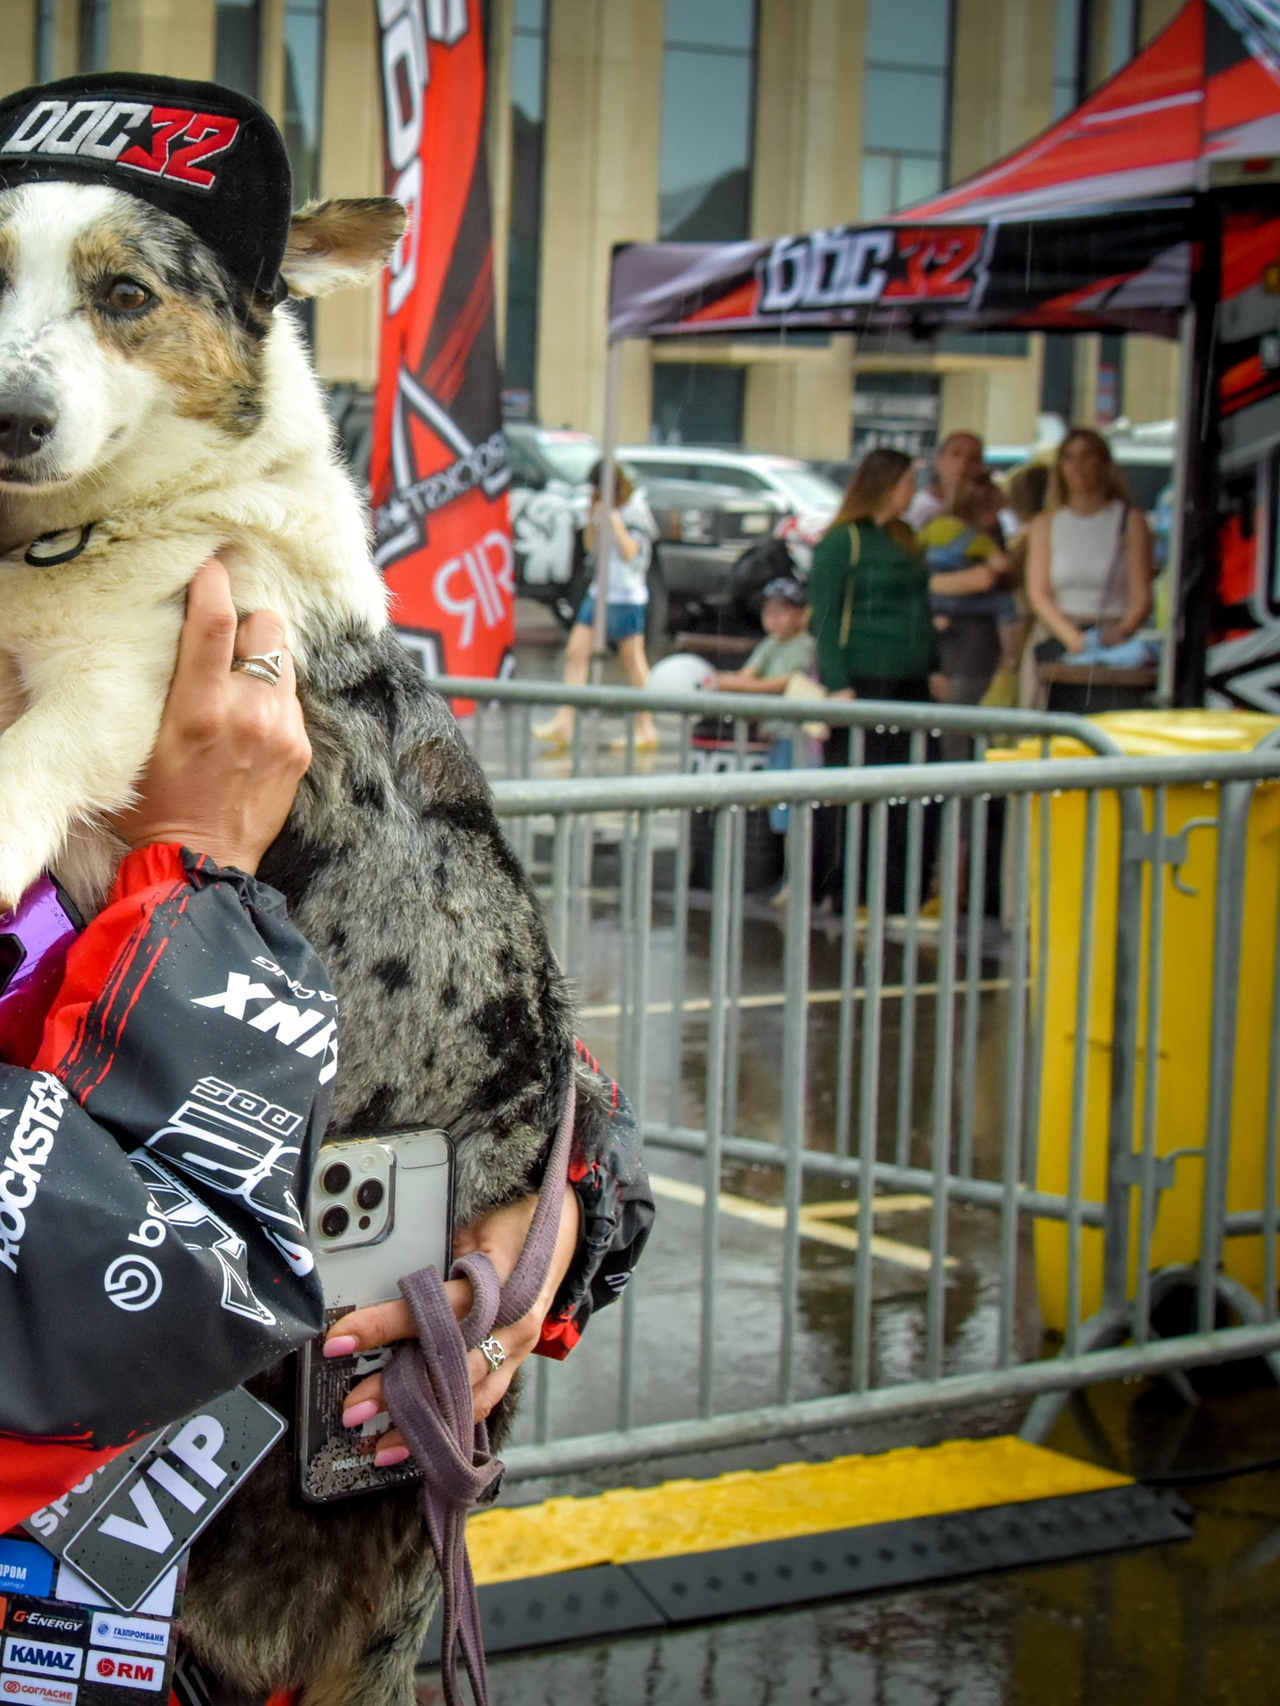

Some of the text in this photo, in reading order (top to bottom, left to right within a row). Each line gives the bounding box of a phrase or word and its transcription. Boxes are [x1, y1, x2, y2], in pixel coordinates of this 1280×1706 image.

[332, 1456, 359, 1472] KARL
[97, 1414, 228, 1554] VIP
[114, 1627, 165, 1642] ГАЗПРОМБАНК
[10, 1644, 75, 1670] KAMAZ
[117, 1662, 154, 1682] RM
[21, 1685, 73, 1700] СОГЛАСИЕ
